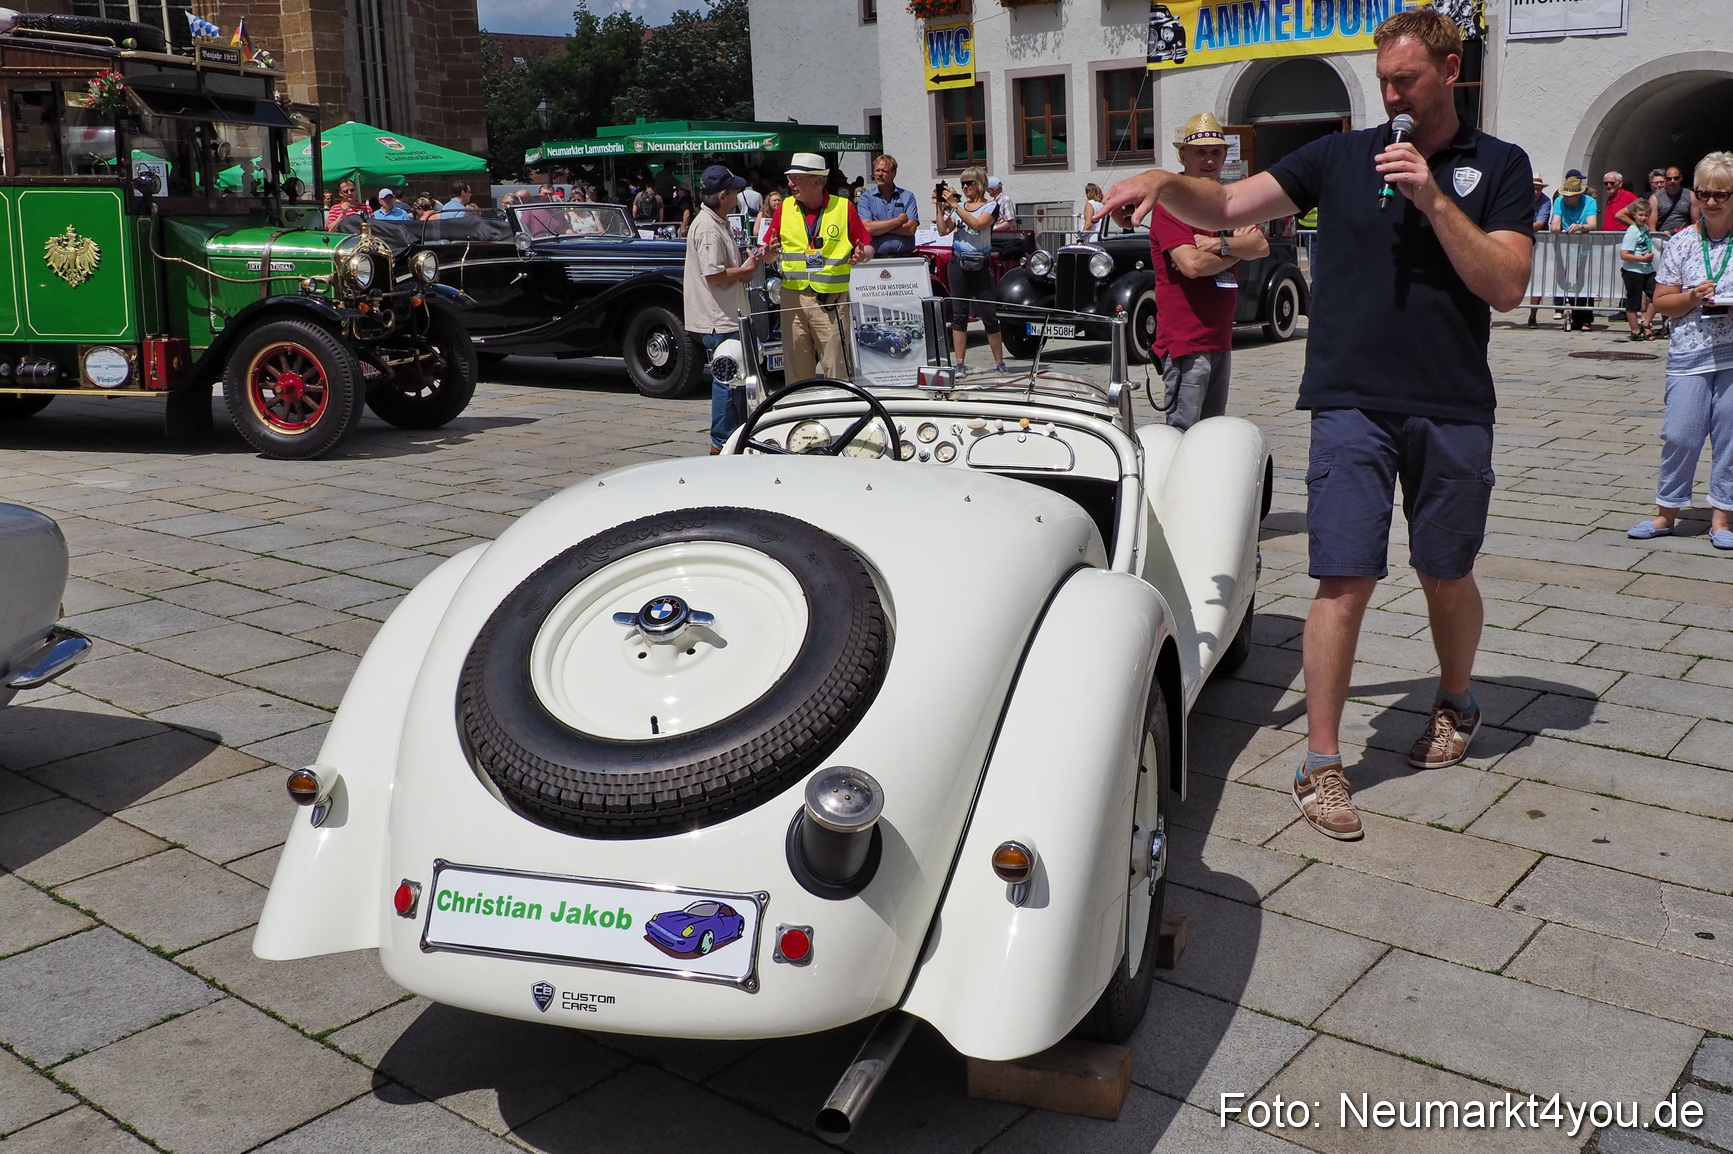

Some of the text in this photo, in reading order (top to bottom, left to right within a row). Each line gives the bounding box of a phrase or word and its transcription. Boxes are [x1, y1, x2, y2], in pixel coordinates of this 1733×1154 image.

[927, 26, 971, 69] WC
[547, 142, 624, 157] Neumarkter Lammsbräu
[647, 140, 760, 151] Neumarkter Lammsbräu
[819, 140, 853, 150] Neumarkter
[887, 282, 919, 290] HISTORISCHE
[861, 289, 914, 298] MAYBACH-FAHRZEUGE
[1053, 326, 1074, 337] 508H
[650, 598, 680, 610] BMW
[436, 889, 633, 931] Christian Jakob
[562, 991, 616, 1005] CUSTOM
[562, 1001, 598, 1013] CARS
